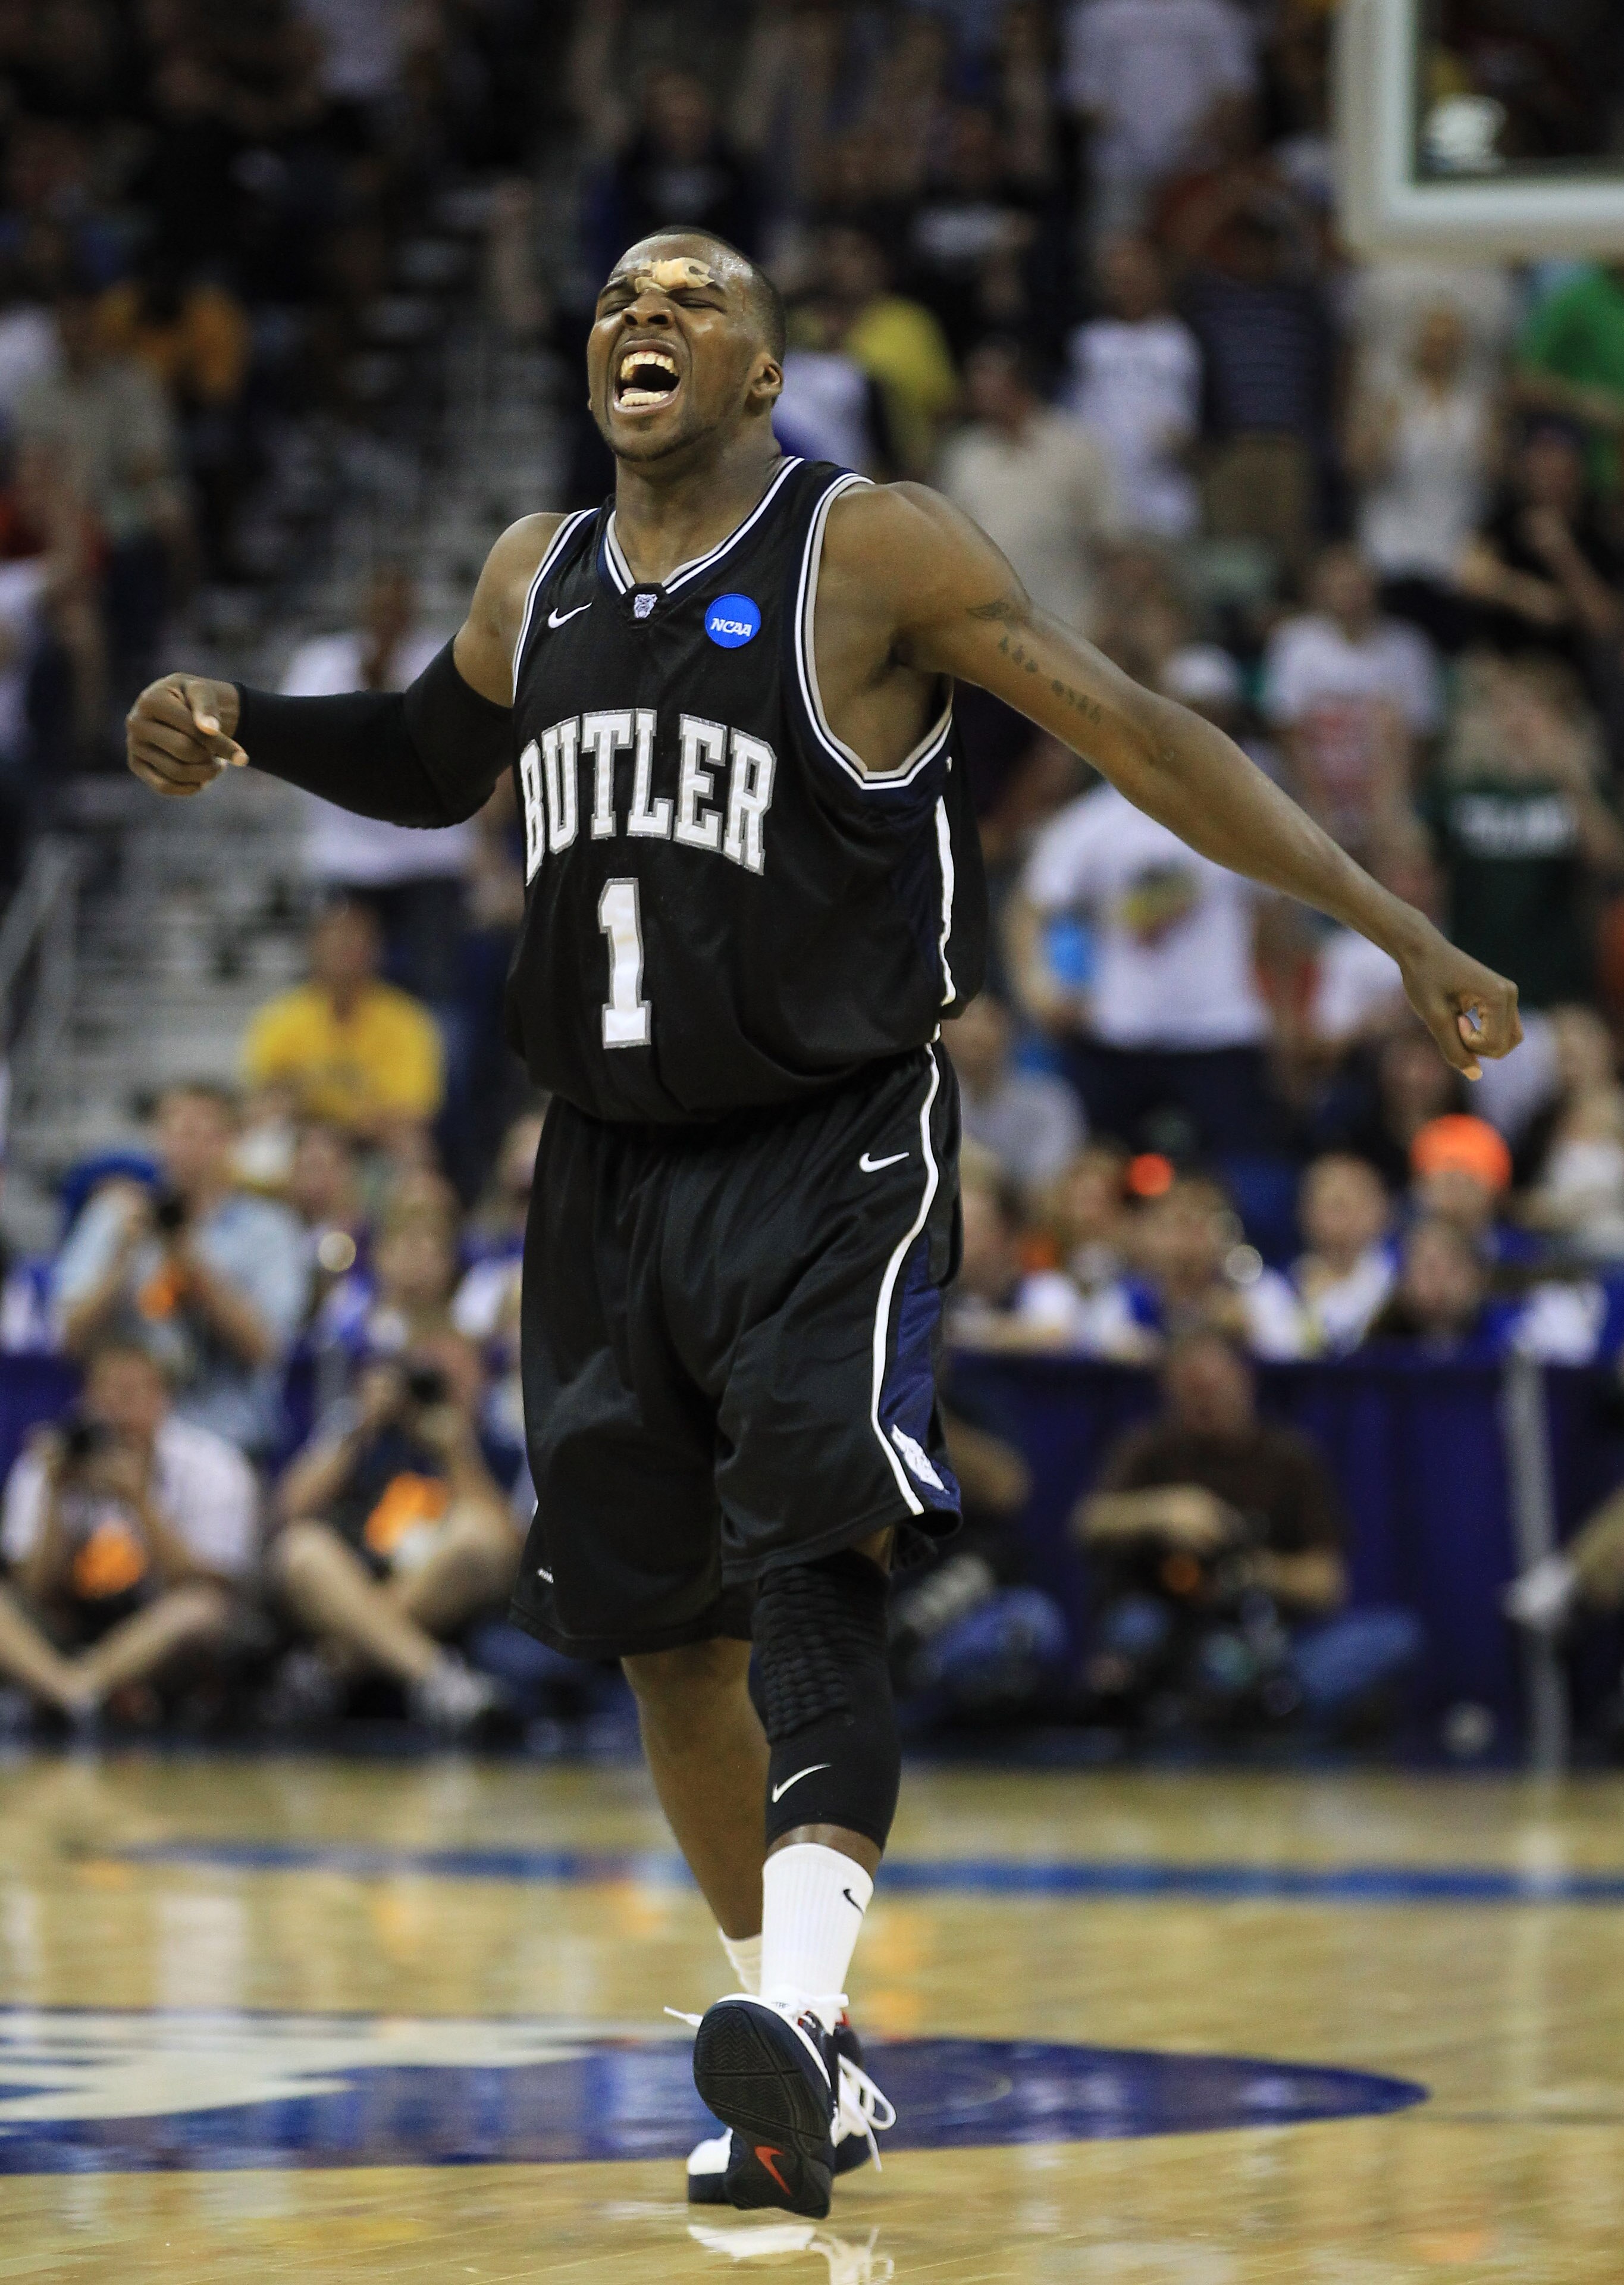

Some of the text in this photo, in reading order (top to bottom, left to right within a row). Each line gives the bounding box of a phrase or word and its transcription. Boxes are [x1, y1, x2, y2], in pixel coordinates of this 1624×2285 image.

[710, 618, 752, 637] NCAA
[519, 709, 776, 885] BUTLER
[598, 878, 651, 1049] 1
